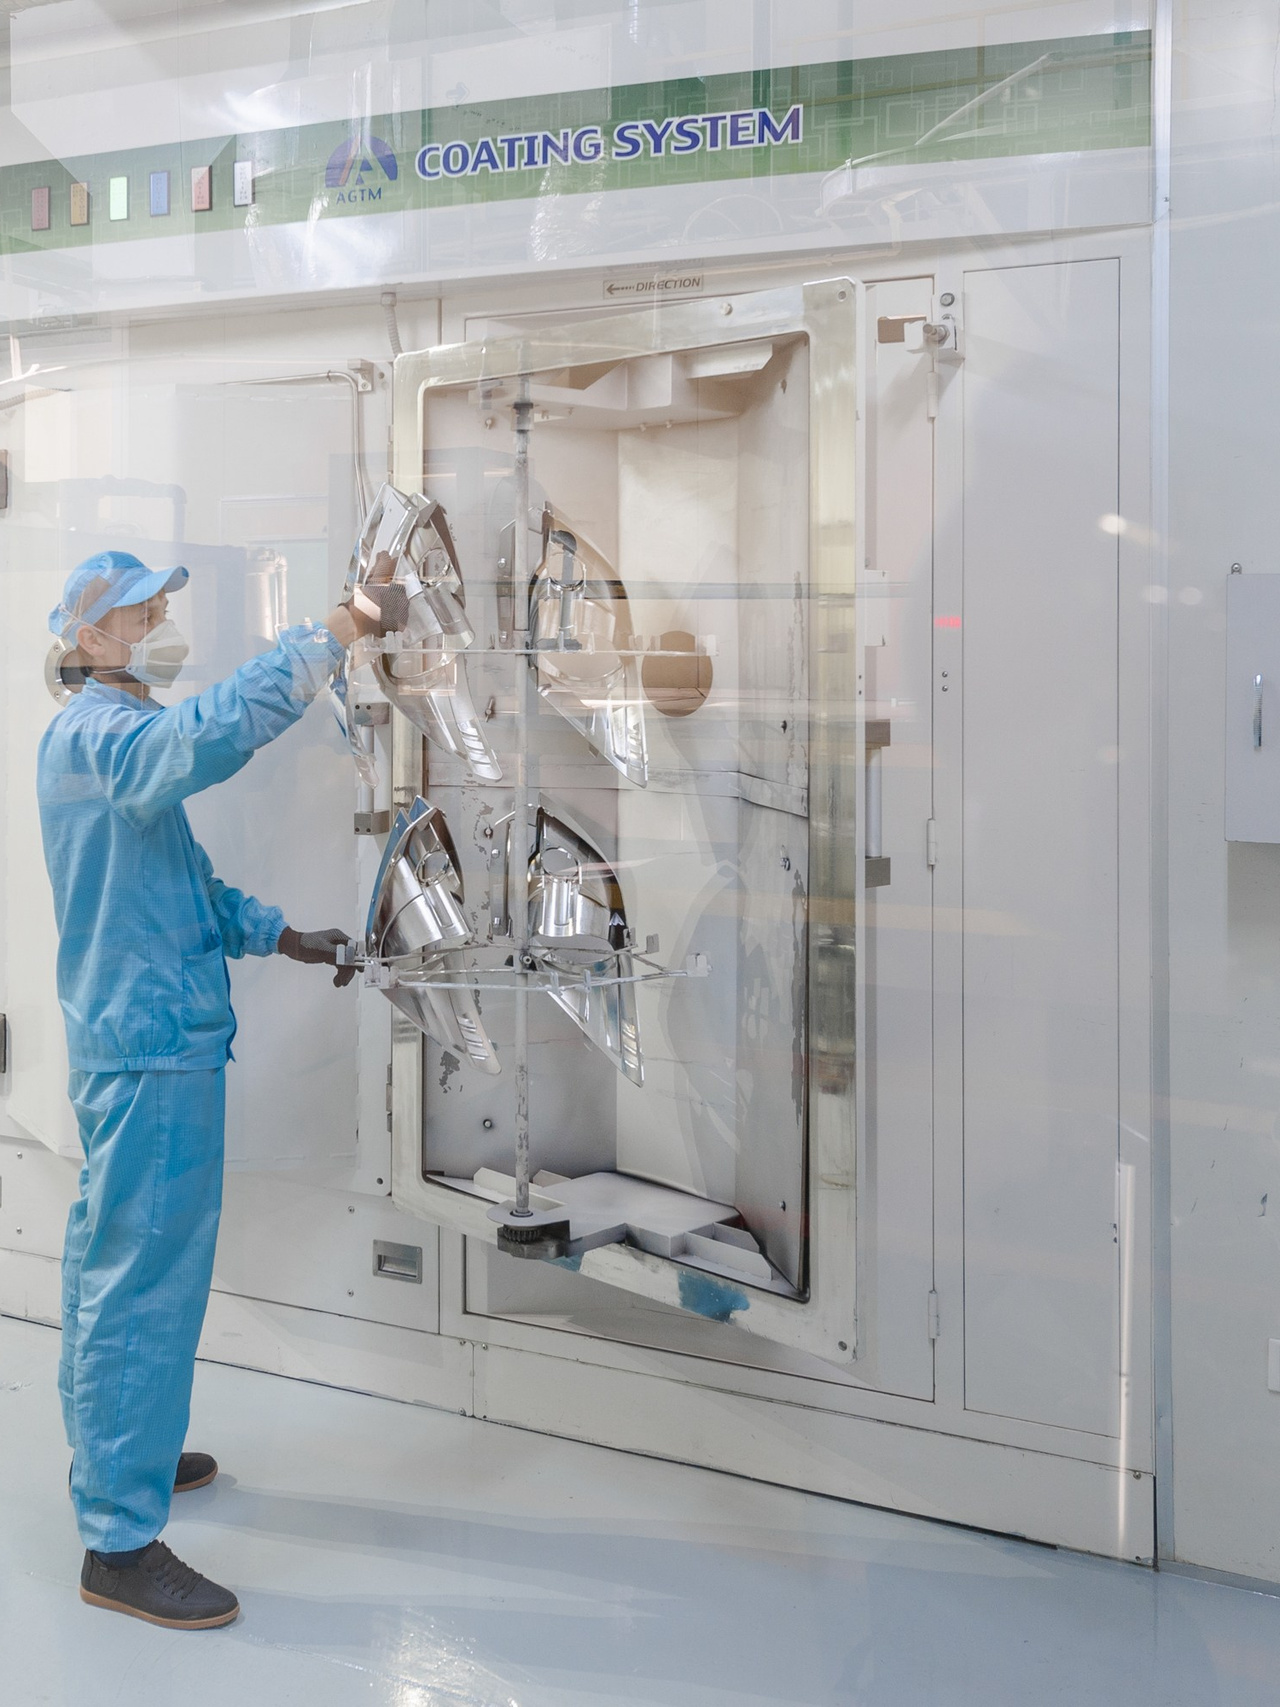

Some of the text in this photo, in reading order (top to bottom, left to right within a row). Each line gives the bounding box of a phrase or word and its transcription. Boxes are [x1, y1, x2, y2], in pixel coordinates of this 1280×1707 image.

[417, 105, 803, 179] COATING SYSTEM
[336, 187, 382, 205] AGTM
[636, 277, 701, 292] DIRECTION
